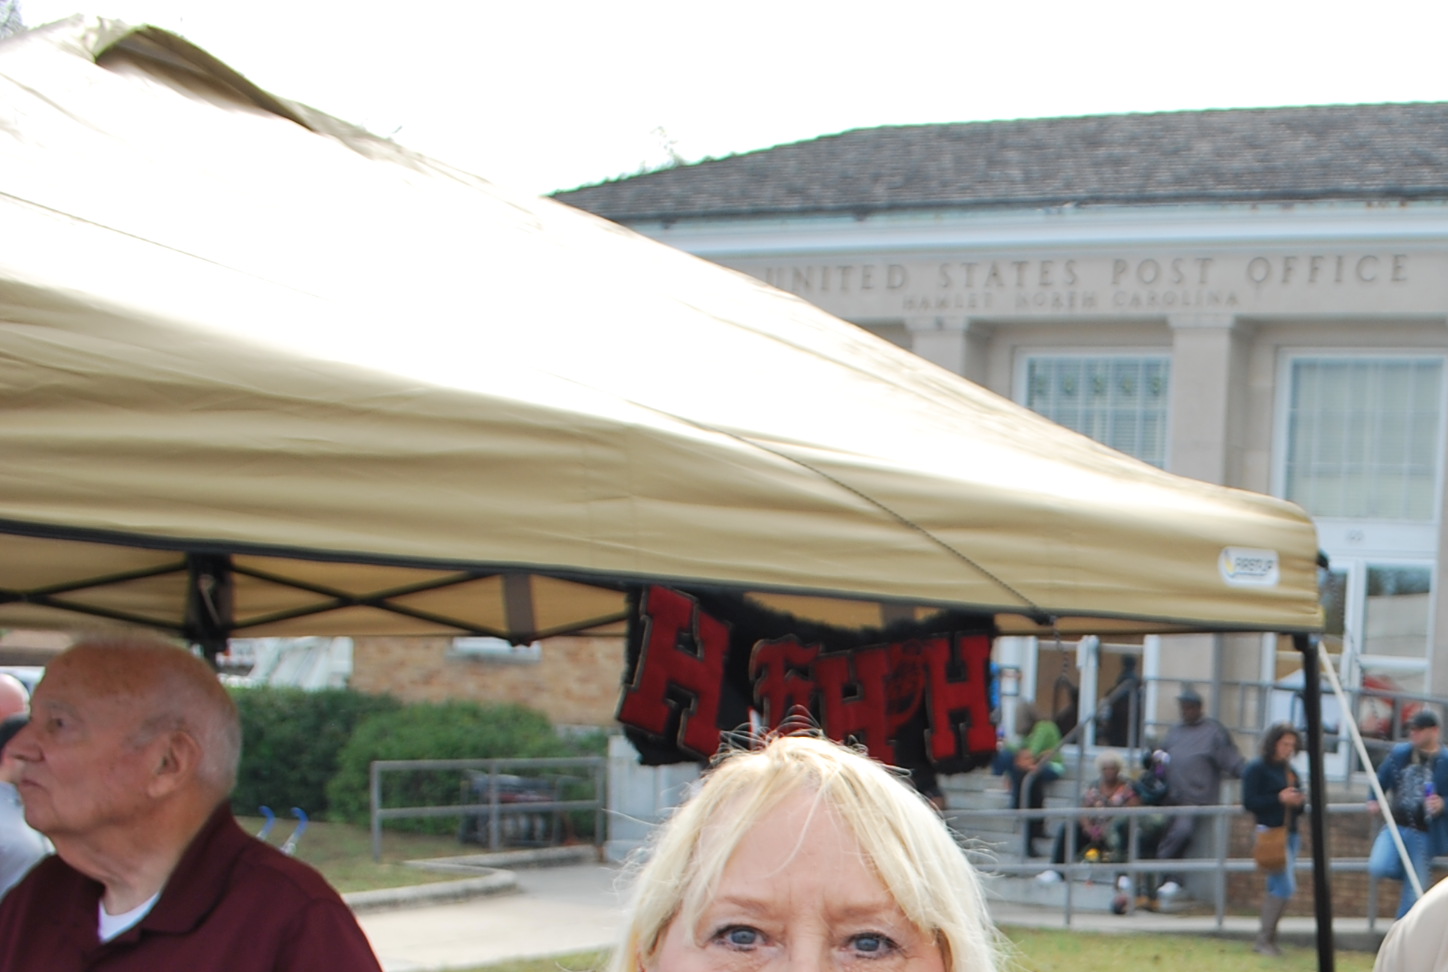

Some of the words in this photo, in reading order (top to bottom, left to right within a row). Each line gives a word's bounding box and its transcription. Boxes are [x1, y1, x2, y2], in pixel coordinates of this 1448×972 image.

[765, 263, 909, 292] UNITED
[937, 259, 1078, 289] STATES
[1110, 257, 1214, 285] POST
[1246, 253, 1408, 285] OFFICE
[1112, 289, 1241, 308] CAROLINA
